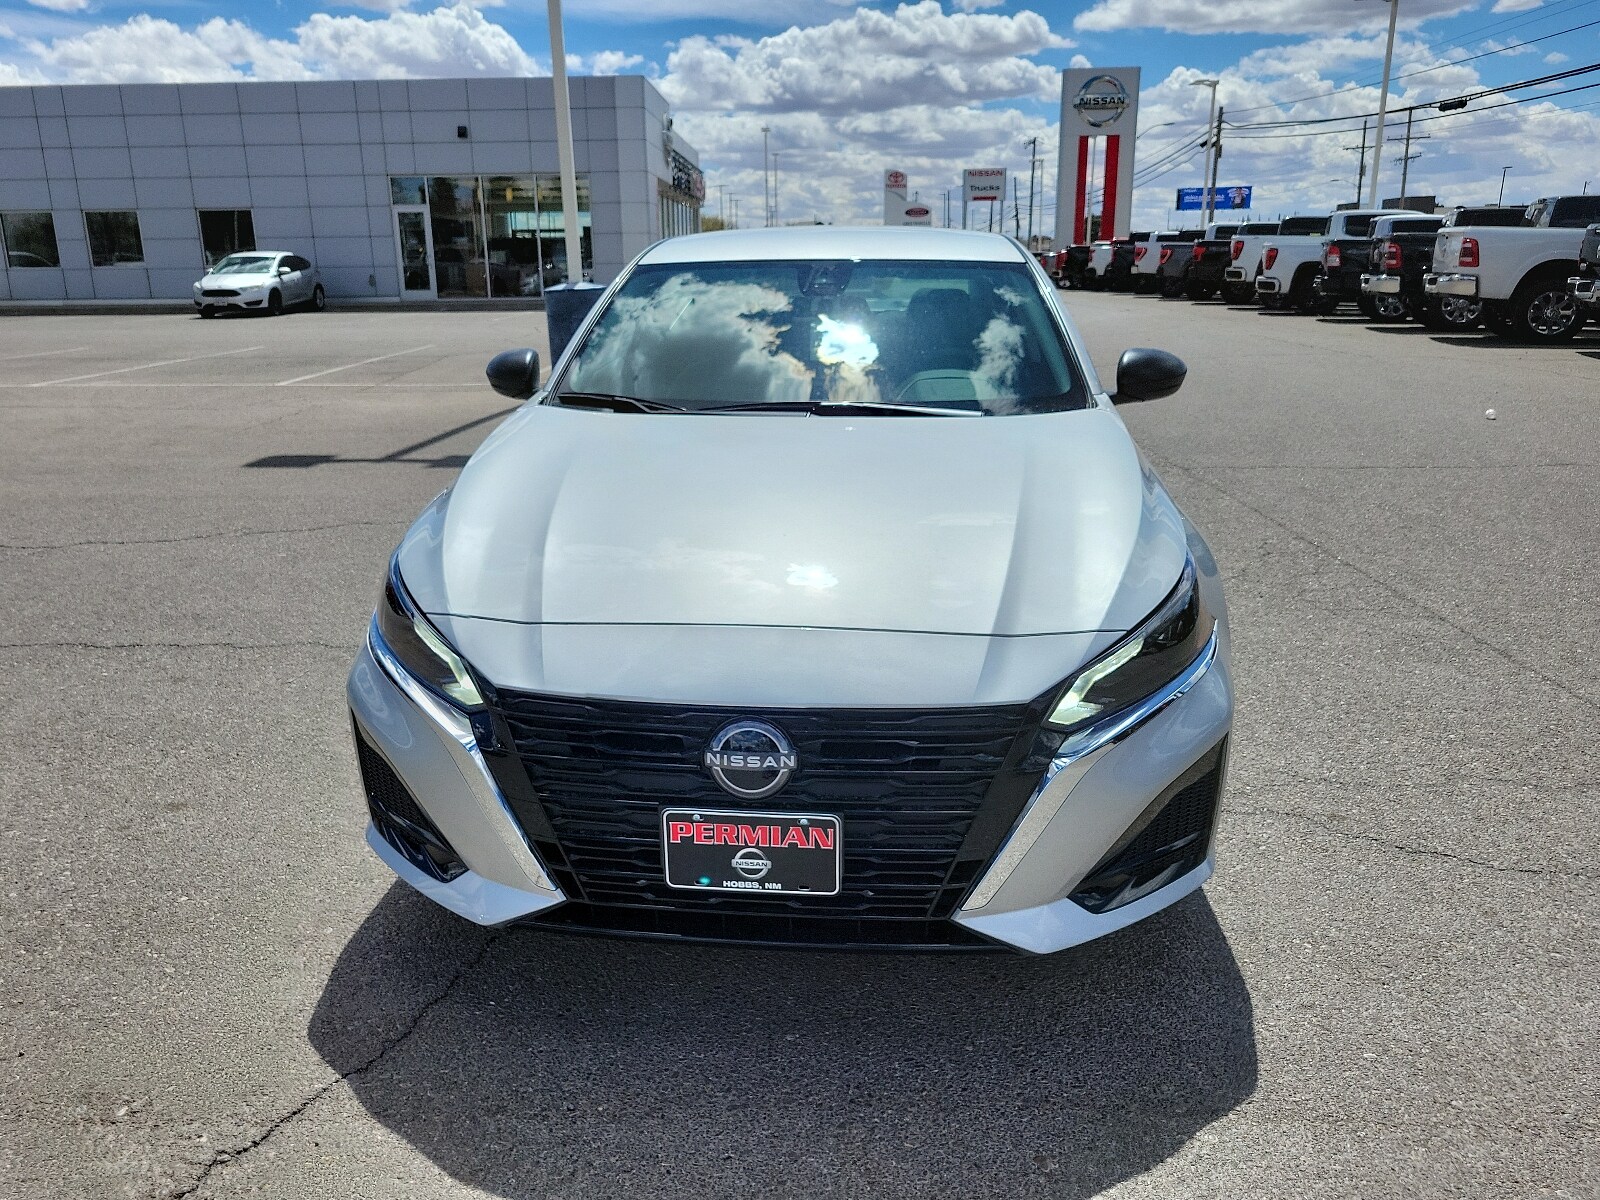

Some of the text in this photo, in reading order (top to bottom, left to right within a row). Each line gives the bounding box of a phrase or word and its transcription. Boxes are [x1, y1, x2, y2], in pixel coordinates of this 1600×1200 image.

[1079, 96, 1125, 105] NISSAN
[706, 752, 795, 768] NISSAN
[669, 821, 834, 849] PERMIAN
[723, 880, 782, 890] HOBBS, NM
